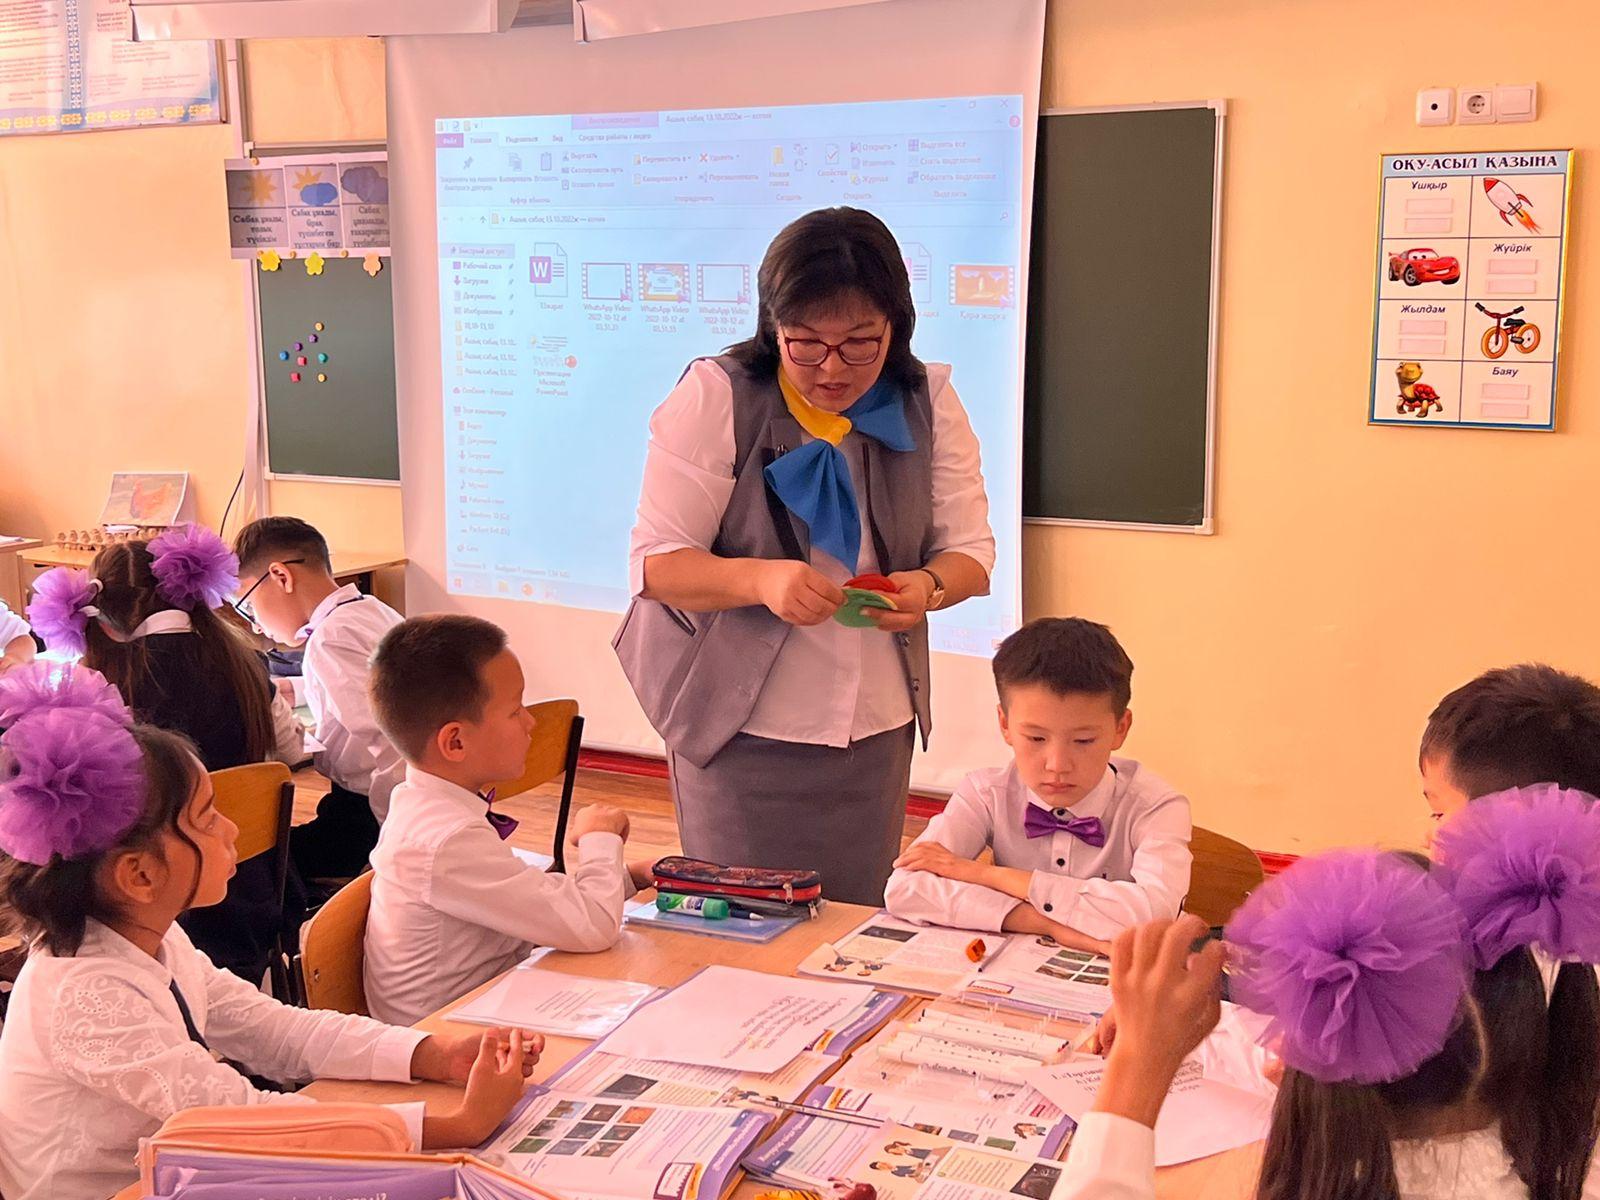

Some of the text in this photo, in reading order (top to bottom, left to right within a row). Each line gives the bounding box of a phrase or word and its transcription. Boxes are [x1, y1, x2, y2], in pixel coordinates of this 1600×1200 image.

[1392, 156, 1558, 173] ОҚУ-АСЫЛ ҚАЗЫНА
[1492, 243, 1532, 254] Жүйрік
[532, 262, 548, 278] W
[1400, 304, 1446, 314] Жылдам
[1492, 366, 1519, 378] Баяу
